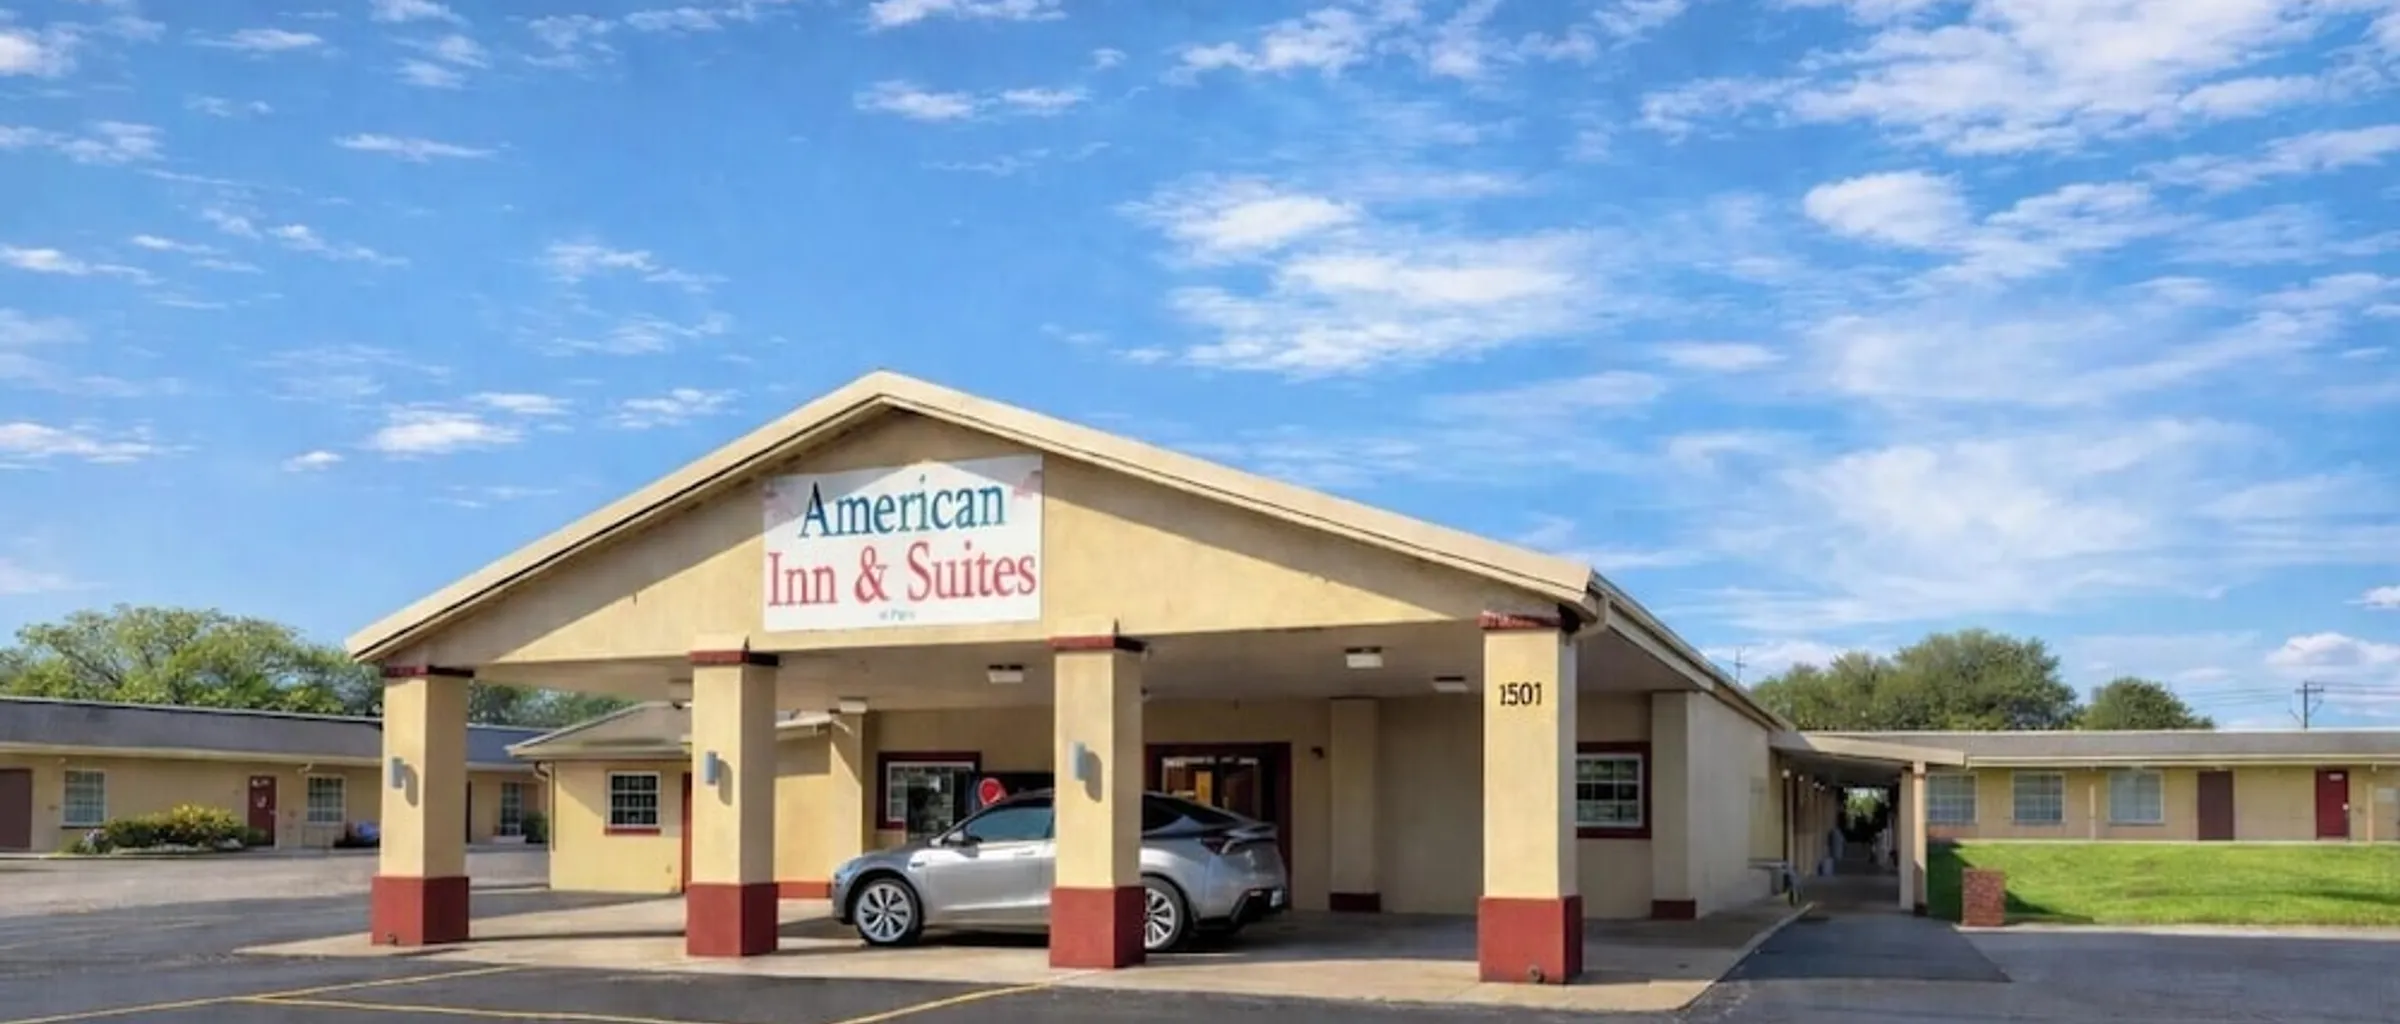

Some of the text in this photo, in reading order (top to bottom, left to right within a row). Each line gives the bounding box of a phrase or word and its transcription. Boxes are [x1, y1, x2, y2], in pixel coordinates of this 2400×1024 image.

[799, 474, 1006, 538] American
[767, 540, 1037, 607] Inn & Suites
[1499, 682, 1542, 706] 1501
